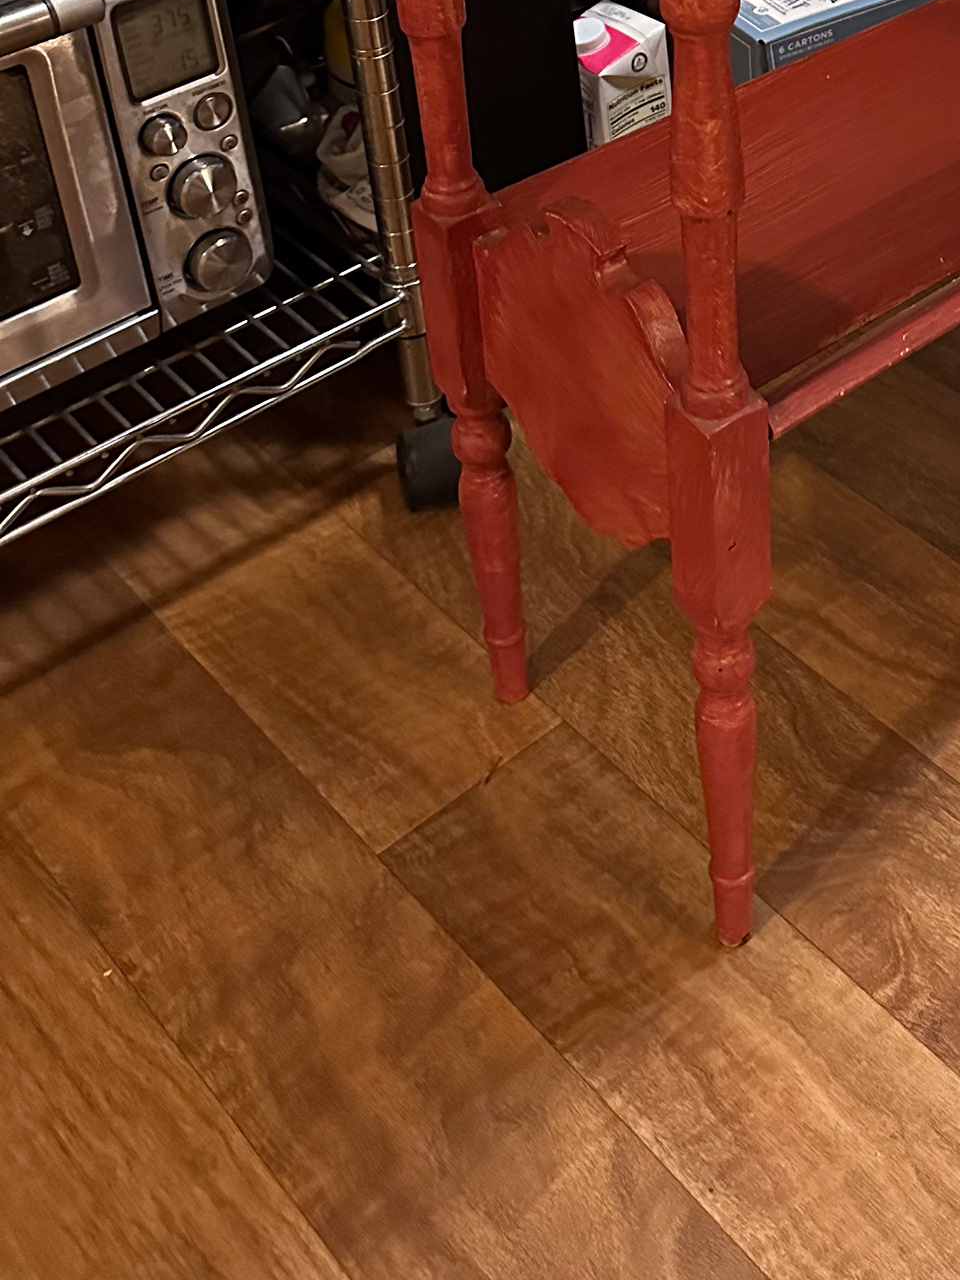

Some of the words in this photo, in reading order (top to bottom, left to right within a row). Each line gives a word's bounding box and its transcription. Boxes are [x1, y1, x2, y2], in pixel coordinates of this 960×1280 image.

[779, 46, 785, 54] 6
[787, 29, 833, 51] CARTONS
[608, 87, 639, 110] Nutrition
[640, 78, 663, 93] Facts
[650, 101, 666, 114] 140
[611, 118, 635, 136] Calories
